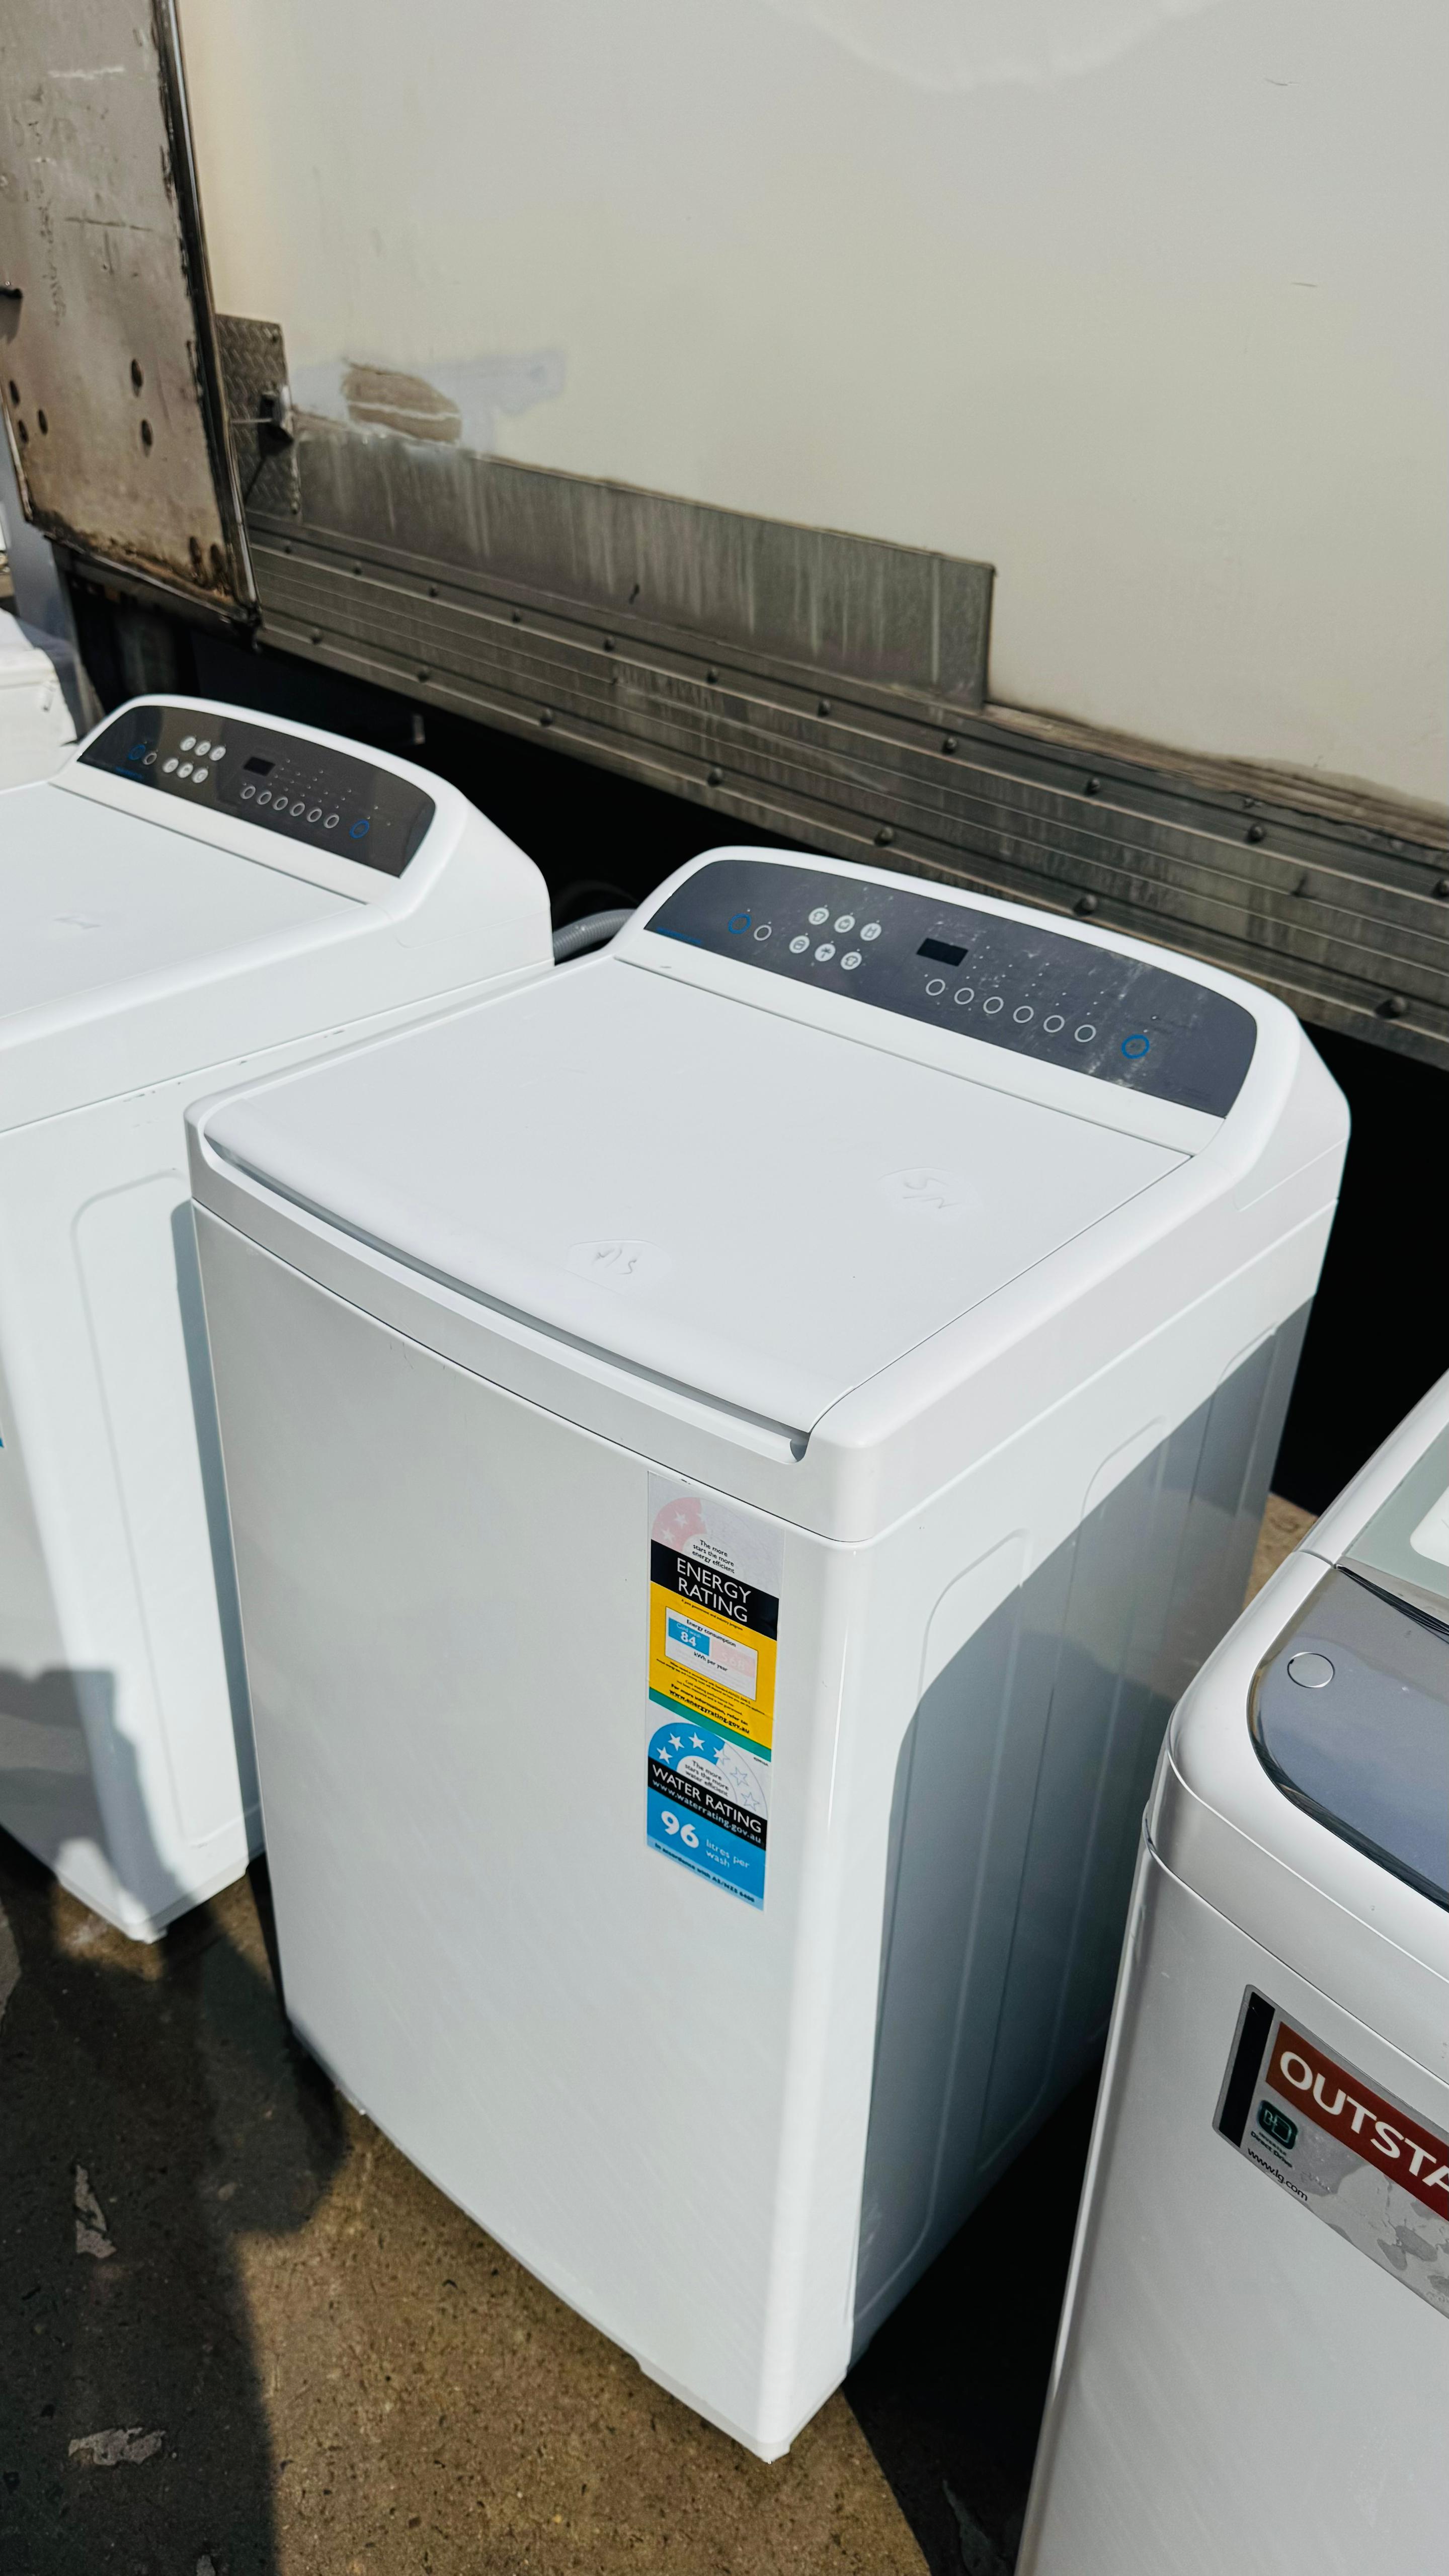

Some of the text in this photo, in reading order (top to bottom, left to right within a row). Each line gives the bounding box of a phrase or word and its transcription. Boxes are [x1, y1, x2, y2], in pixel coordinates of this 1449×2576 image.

[692, 1550, 735, 1574] energy efficient
[693, 1544, 734, 1567] stars the more
[700, 1539, 728, 1557] The more
[677, 1557, 751, 1603] ENERGY
[678, 1577, 748, 1623] RATING
[680, 1630, 696, 1648] 84
[687, 1619, 736, 1648] Energy consumption
[694, 1651, 706, 1661] kWh
[707, 1658, 715, 1667] per
[716, 1663, 728, 1673] year
[669, 1689, 750, 1735] www.energyrating.gov.au
[685, 1763, 729, 1791] stars the more
[685, 1769, 728, 1797] water efficient
[692, 1759, 721, 1781] The more
[652, 1779, 761, 1843] www.waterrating.gov.au
[653, 1764, 761, 1833] WATER RATING
[661, 1810, 699, 1849] 96
[706, 1839, 750, 1868] litres per
[706, 1850, 730, 1868] wash
[1251, 2131, 1272, 2152] Direct
[1247, 2147, 1308, 2202] www.lg.com
